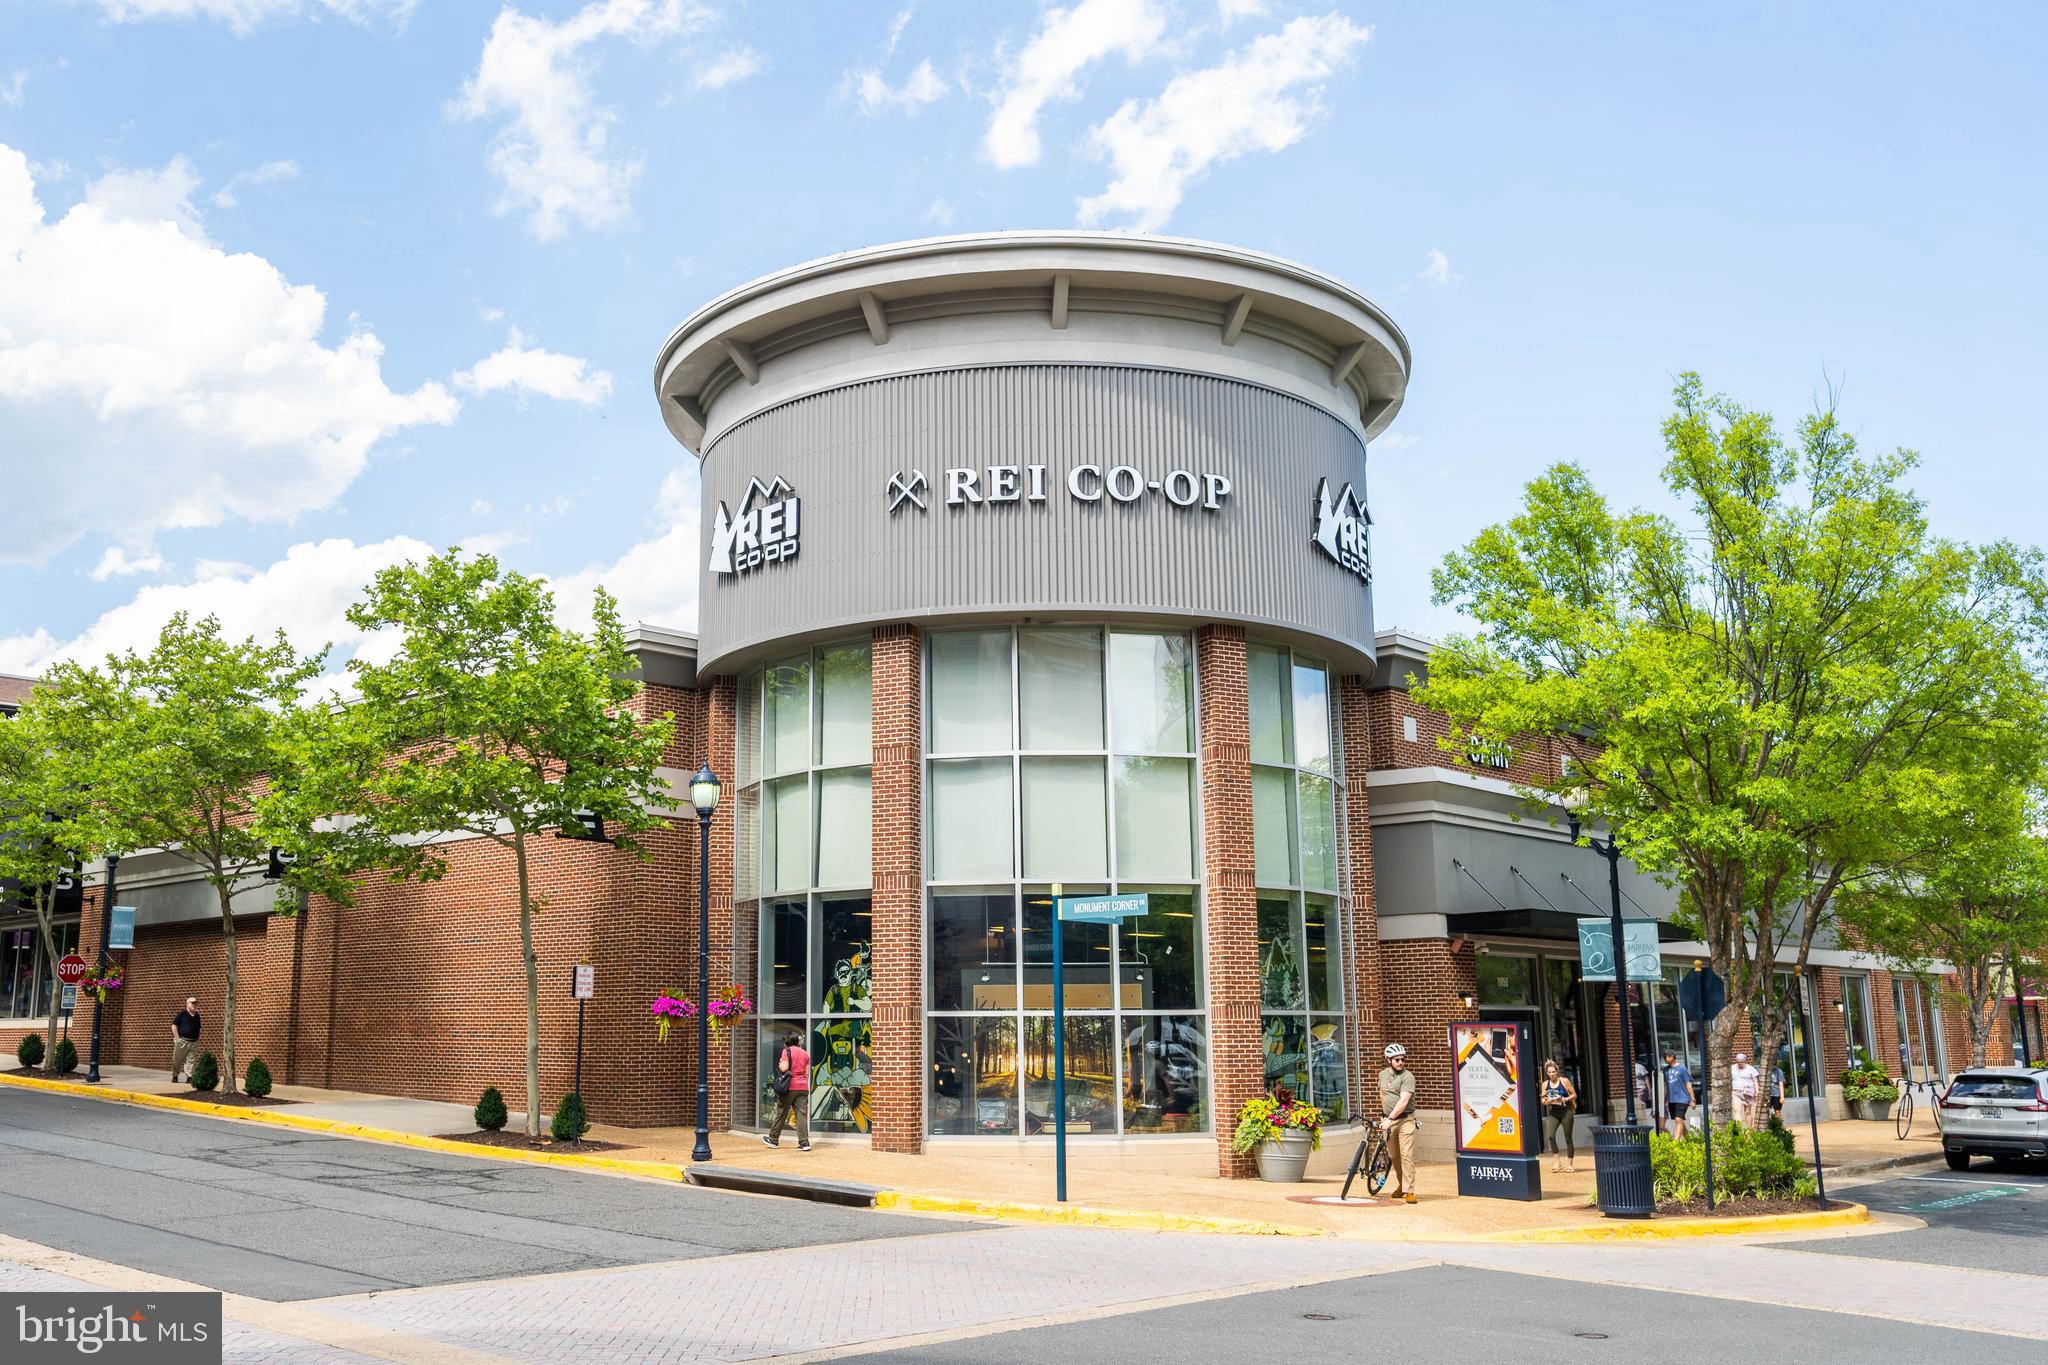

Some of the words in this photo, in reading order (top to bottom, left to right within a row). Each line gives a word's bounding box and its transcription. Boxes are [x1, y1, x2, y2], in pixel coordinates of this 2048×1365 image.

[945, 464, 1047, 504] REI
[1067, 464, 1232, 510] CO-OP
[736, 497, 800, 555] REI
[1073, 901, 1111, 914] MONUMENT
[1111, 899, 1139, 912] CORNER
[60, 963, 85, 976] STOP
[1470, 1165, 1513, 1179] FAIRFAX
